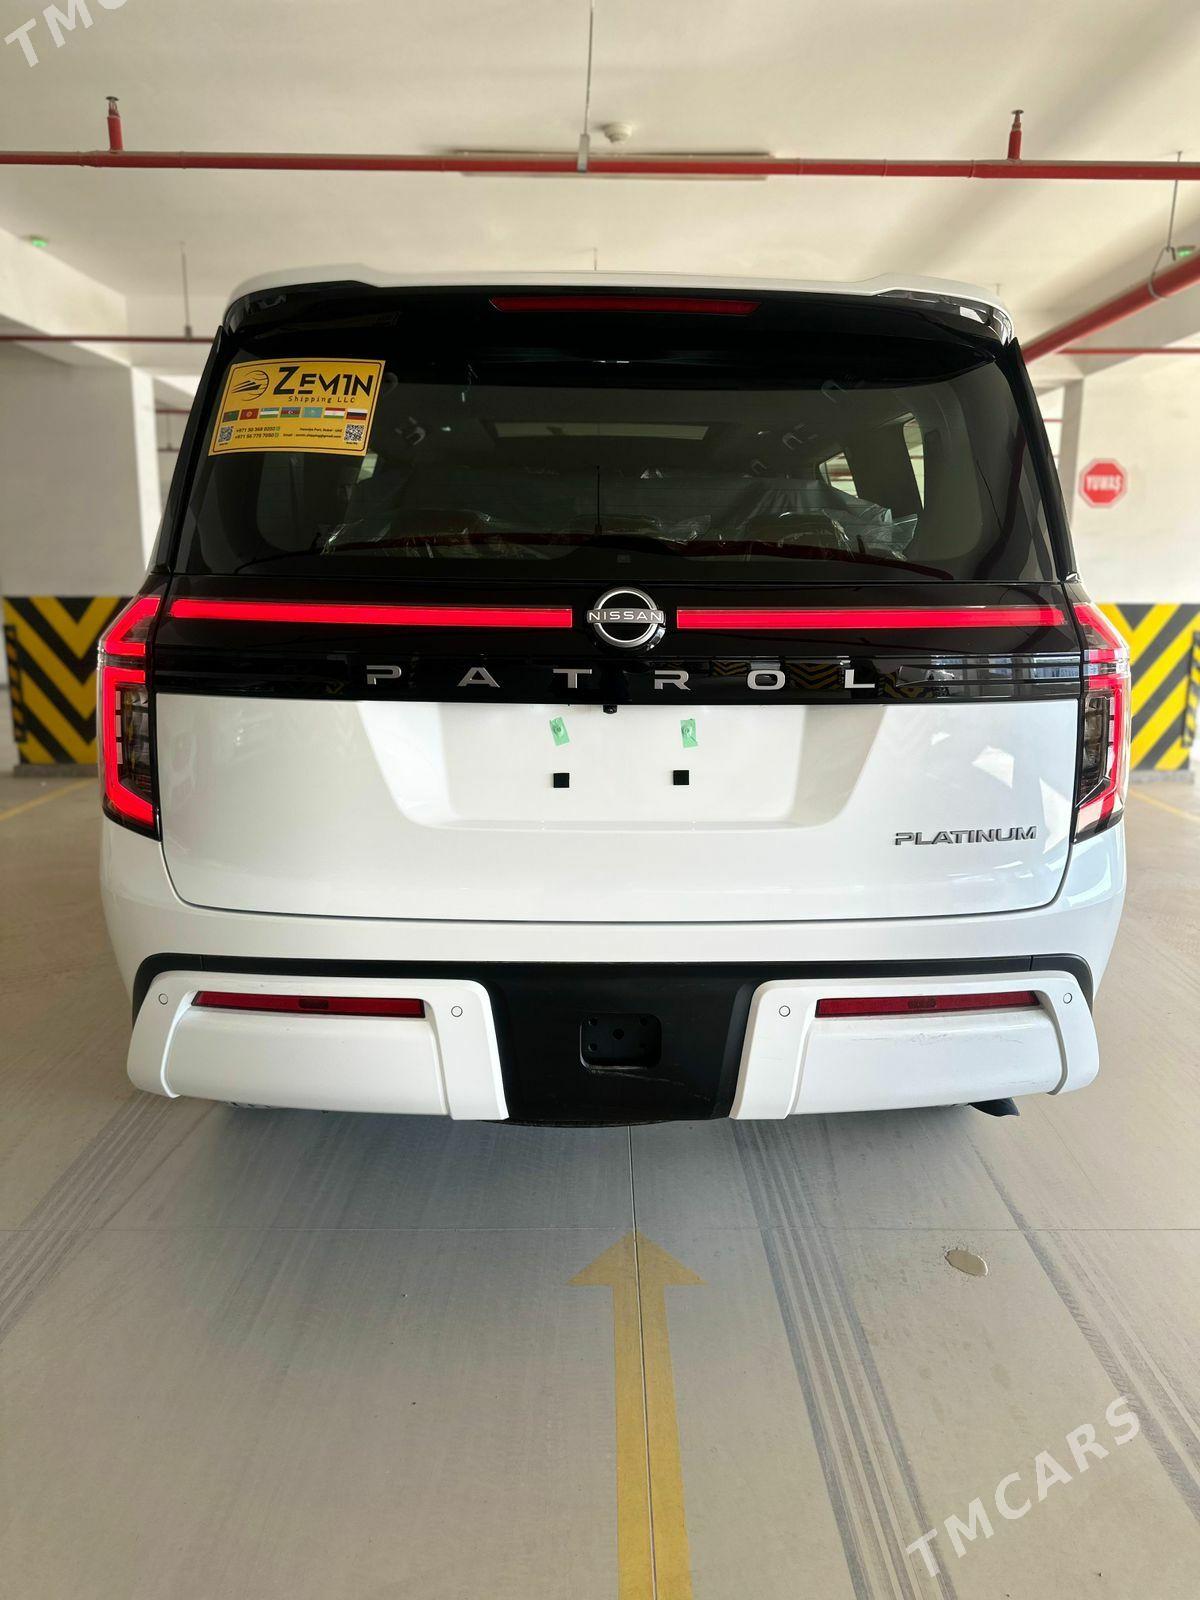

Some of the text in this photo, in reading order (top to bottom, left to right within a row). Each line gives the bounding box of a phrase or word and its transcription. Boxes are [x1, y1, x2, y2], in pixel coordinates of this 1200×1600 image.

[288, 395, 332, 404] Shipping
[589, 611, 662, 621] NISSAN
[366, 664, 876, 691] PATROL
[894, 825, 1037, 846] PLATINUM
